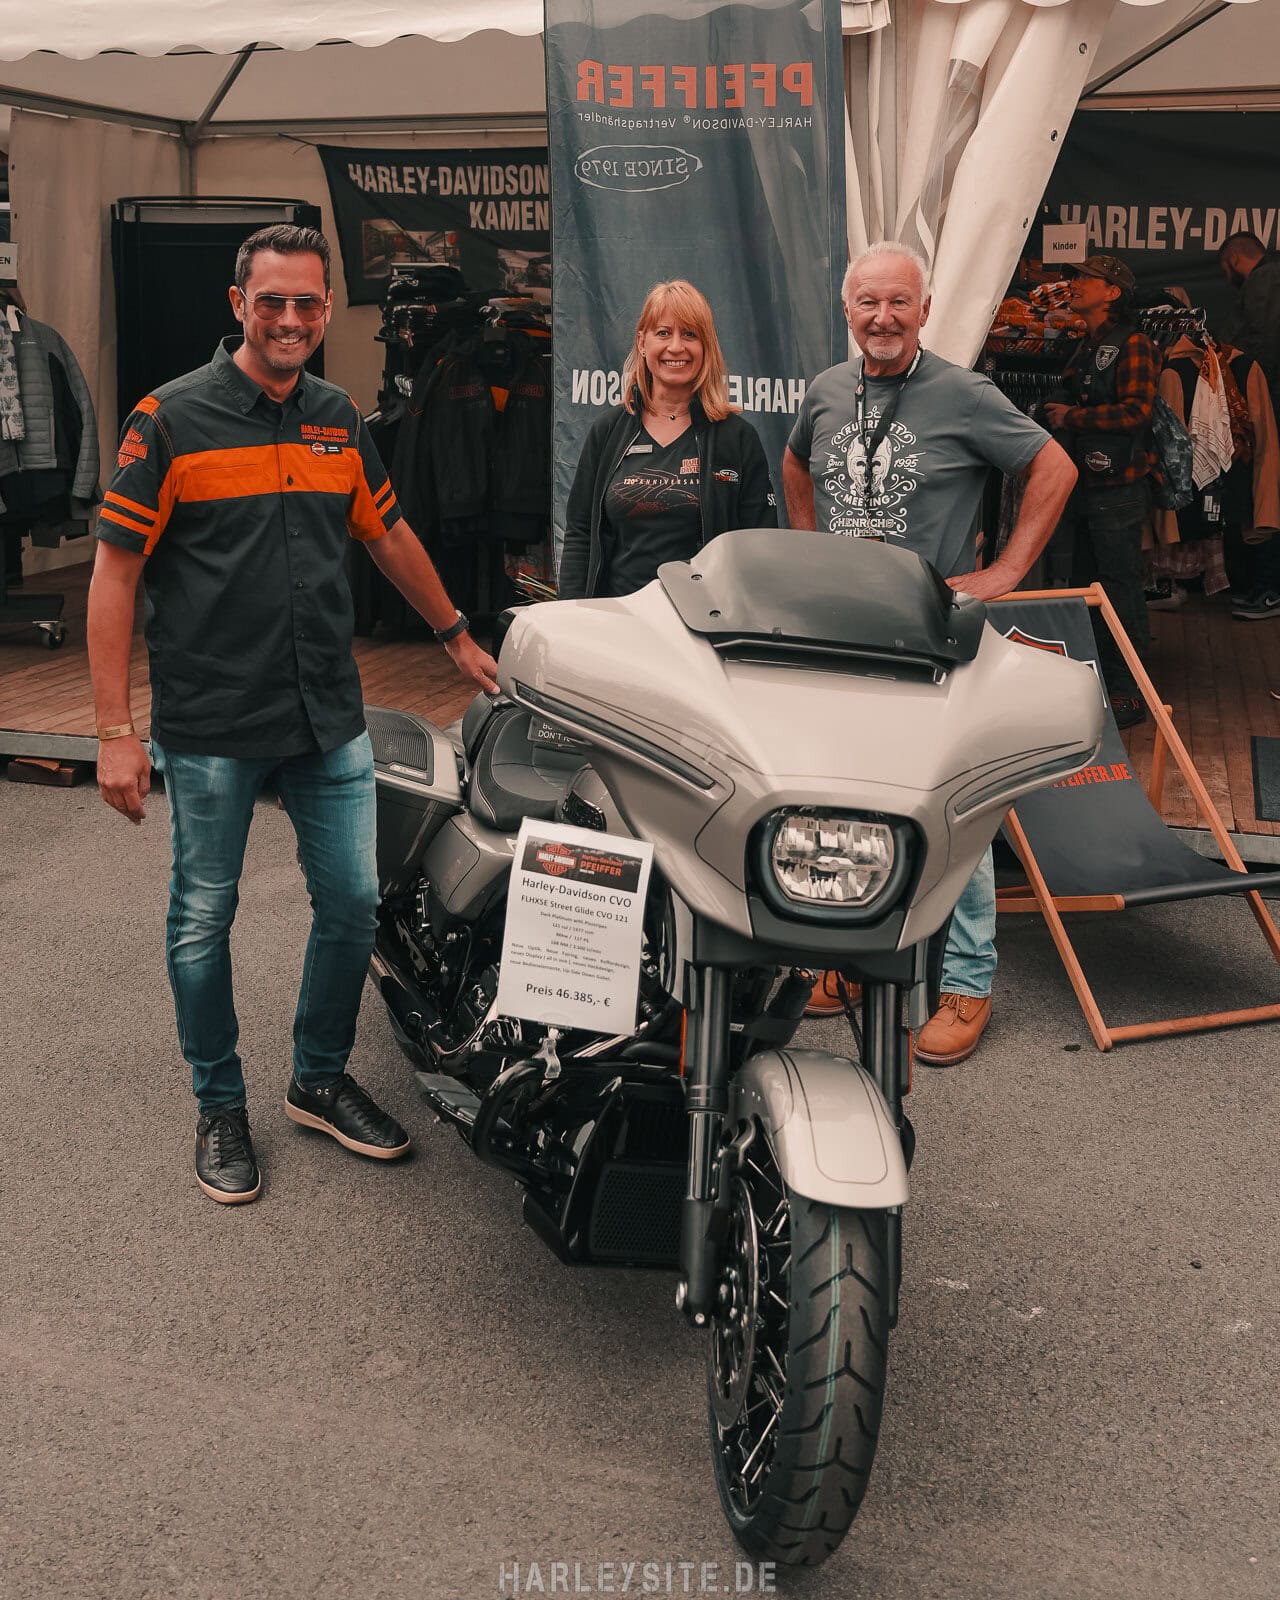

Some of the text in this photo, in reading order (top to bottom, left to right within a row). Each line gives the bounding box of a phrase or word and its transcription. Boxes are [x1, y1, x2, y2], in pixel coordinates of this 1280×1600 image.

[348, 163, 549, 196] HARLEY-DAVIDSON
[469, 200, 549, 231] KAMEN
[1052, 241, 1077, 251] Kinder
[894, 458, 918, 468] 1995
[538, 729, 562, 740] DON'T
[580, 861, 622, 876] PFEIFFER
[521, 877, 631, 908] Harley-Davidson CVO
[521, 896, 628, 922] FLHXSE Street Glide CVO 121
[526, 983, 611, 1007] Preis 46.385,- €
